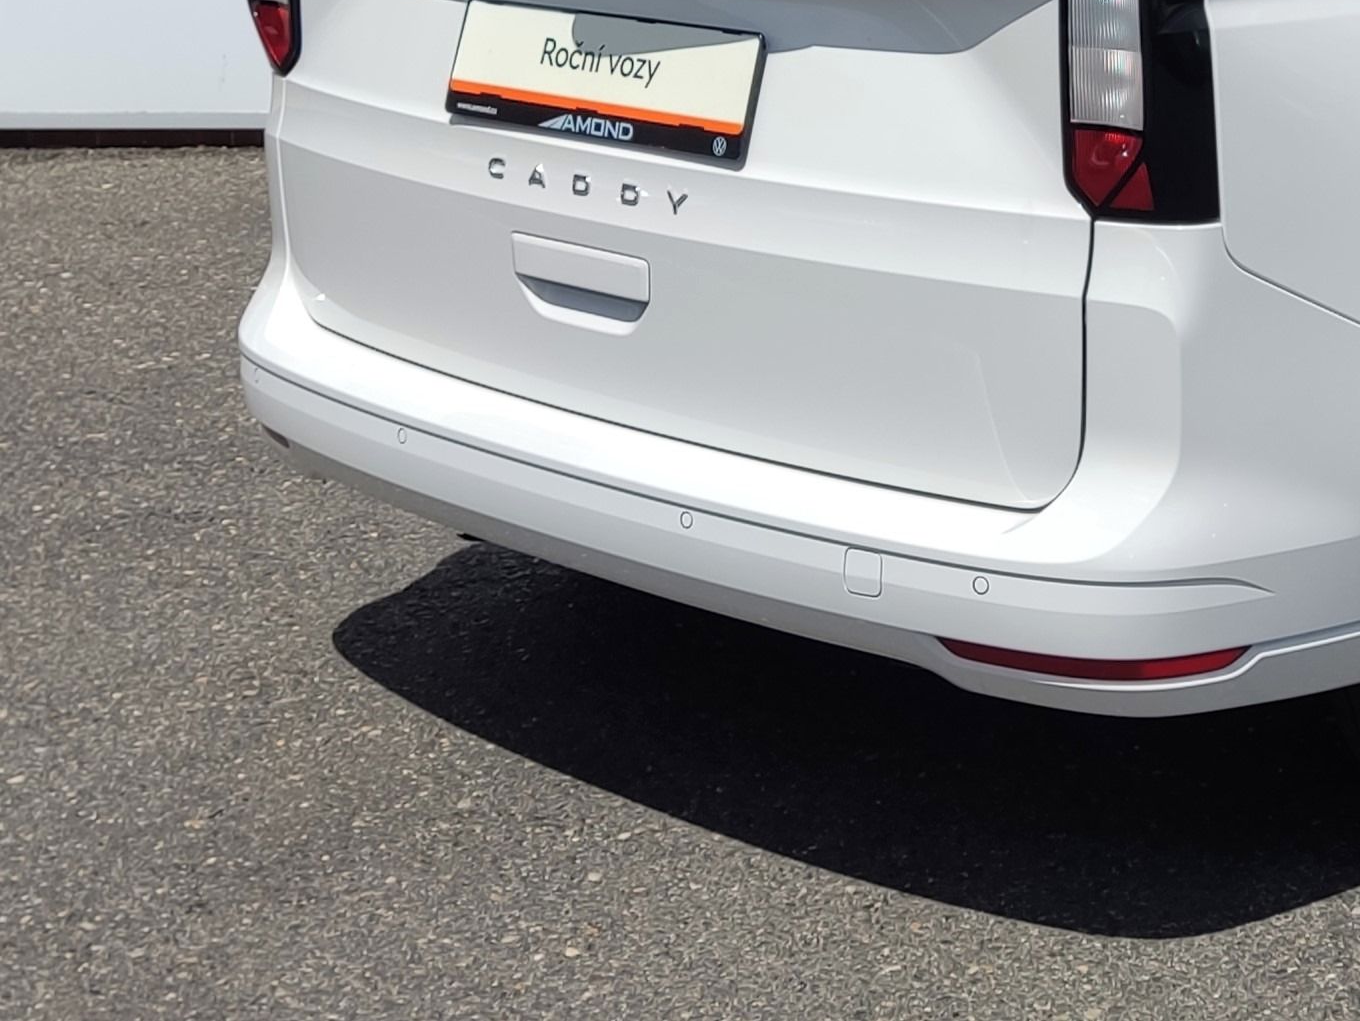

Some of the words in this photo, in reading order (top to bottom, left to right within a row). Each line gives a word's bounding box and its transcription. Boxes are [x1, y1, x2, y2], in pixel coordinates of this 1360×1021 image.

[540, 37, 605, 74] Roční
[608, 54, 661, 89] vozy
[561, 114, 634, 141] AMOND
[488, 157, 688, 215] CADDY
